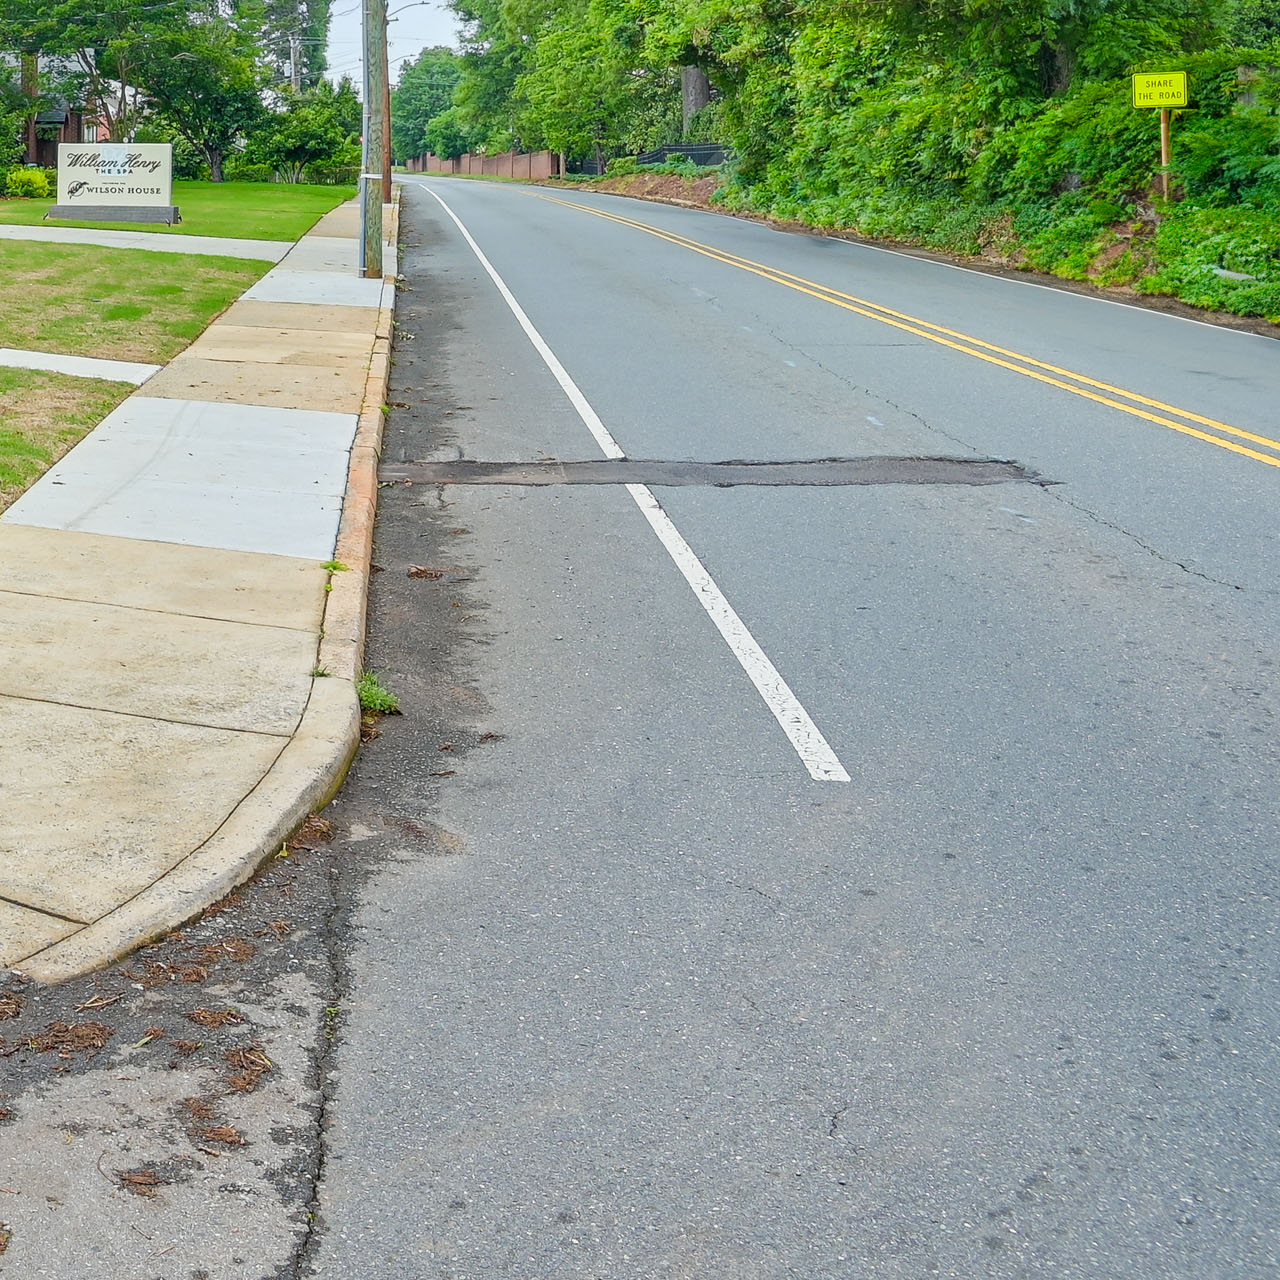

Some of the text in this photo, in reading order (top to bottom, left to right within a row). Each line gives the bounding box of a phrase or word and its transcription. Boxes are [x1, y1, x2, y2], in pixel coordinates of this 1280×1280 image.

[1145, 80, 1174, 88] SHARE
[1138, 91, 1182, 100] THE ROAD
[67, 152, 162, 173] William Henry
[128, 187, 161, 195] HOUSE
